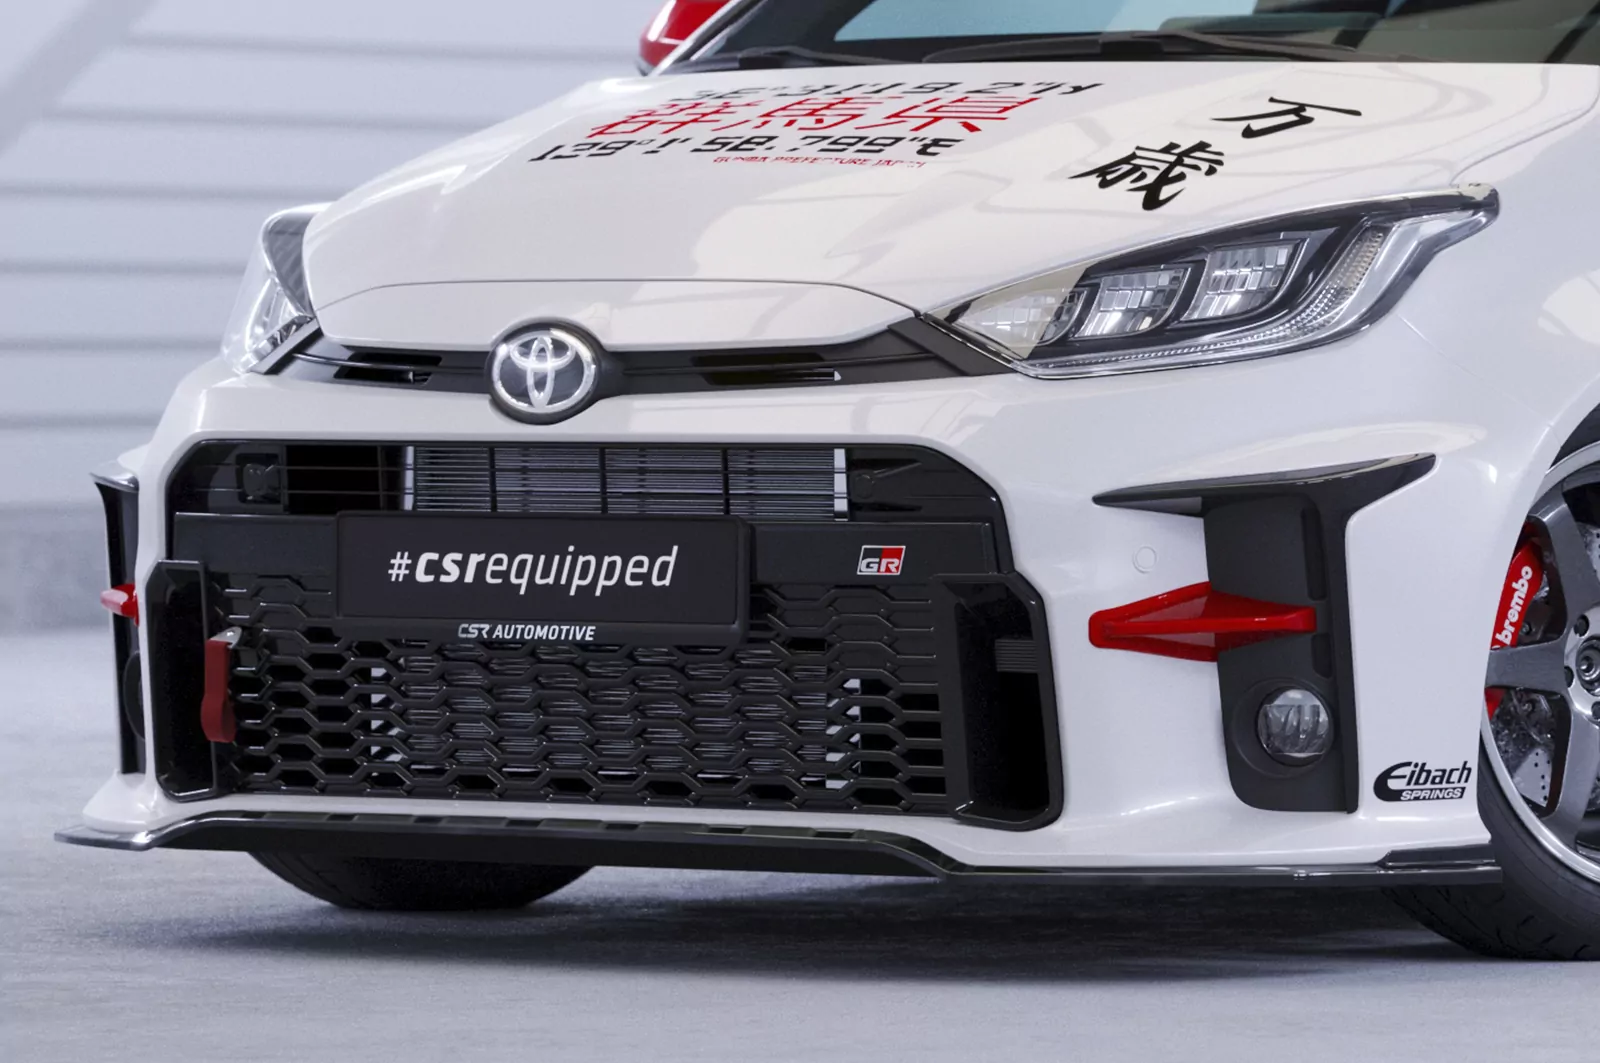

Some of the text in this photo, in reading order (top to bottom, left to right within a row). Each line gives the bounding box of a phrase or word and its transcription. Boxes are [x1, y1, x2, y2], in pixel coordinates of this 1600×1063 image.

[586, 96, 1041, 138] 群馬県
[388, 545, 678, 596] #csrequipped
[860, 557, 900, 573] GR
[1496, 565, 1533, 646] brembo
[457, 623, 597, 641] CSR AUTOMOTIVE
[1373, 760, 1472, 802] Eibach
[1400, 787, 1463, 801] SPRINGS
